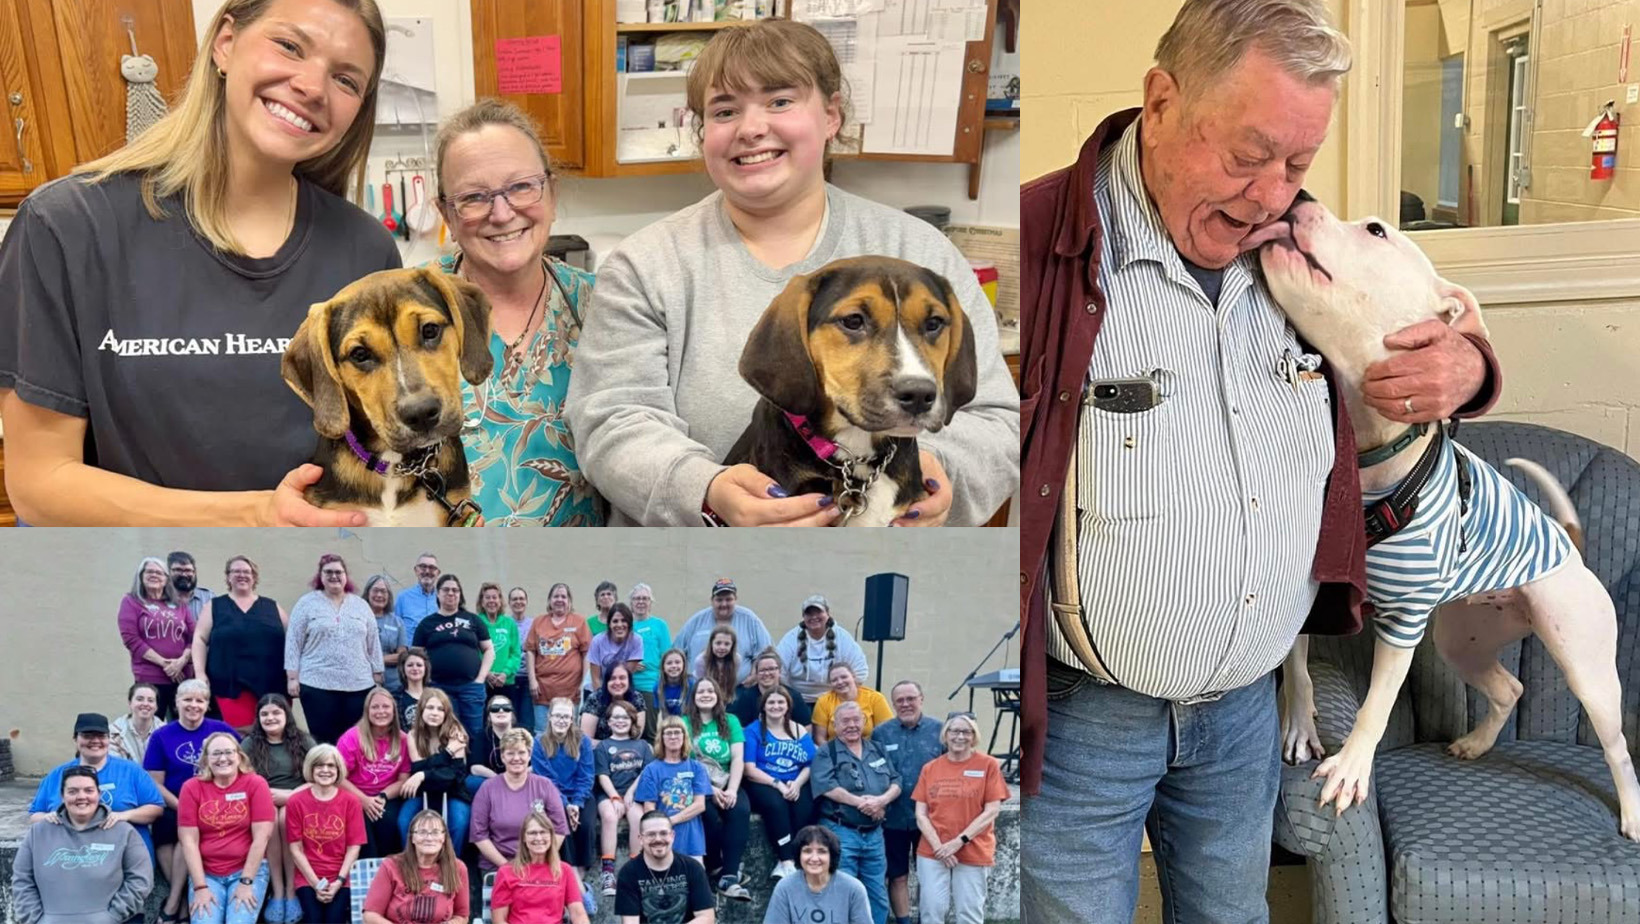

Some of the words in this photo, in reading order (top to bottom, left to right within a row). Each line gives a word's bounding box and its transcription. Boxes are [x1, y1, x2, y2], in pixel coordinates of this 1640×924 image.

[98, 329, 221, 356] AMERICAN
[224, 333, 294, 354] HEAR
[764, 740, 808, 763] CLIPPERS
